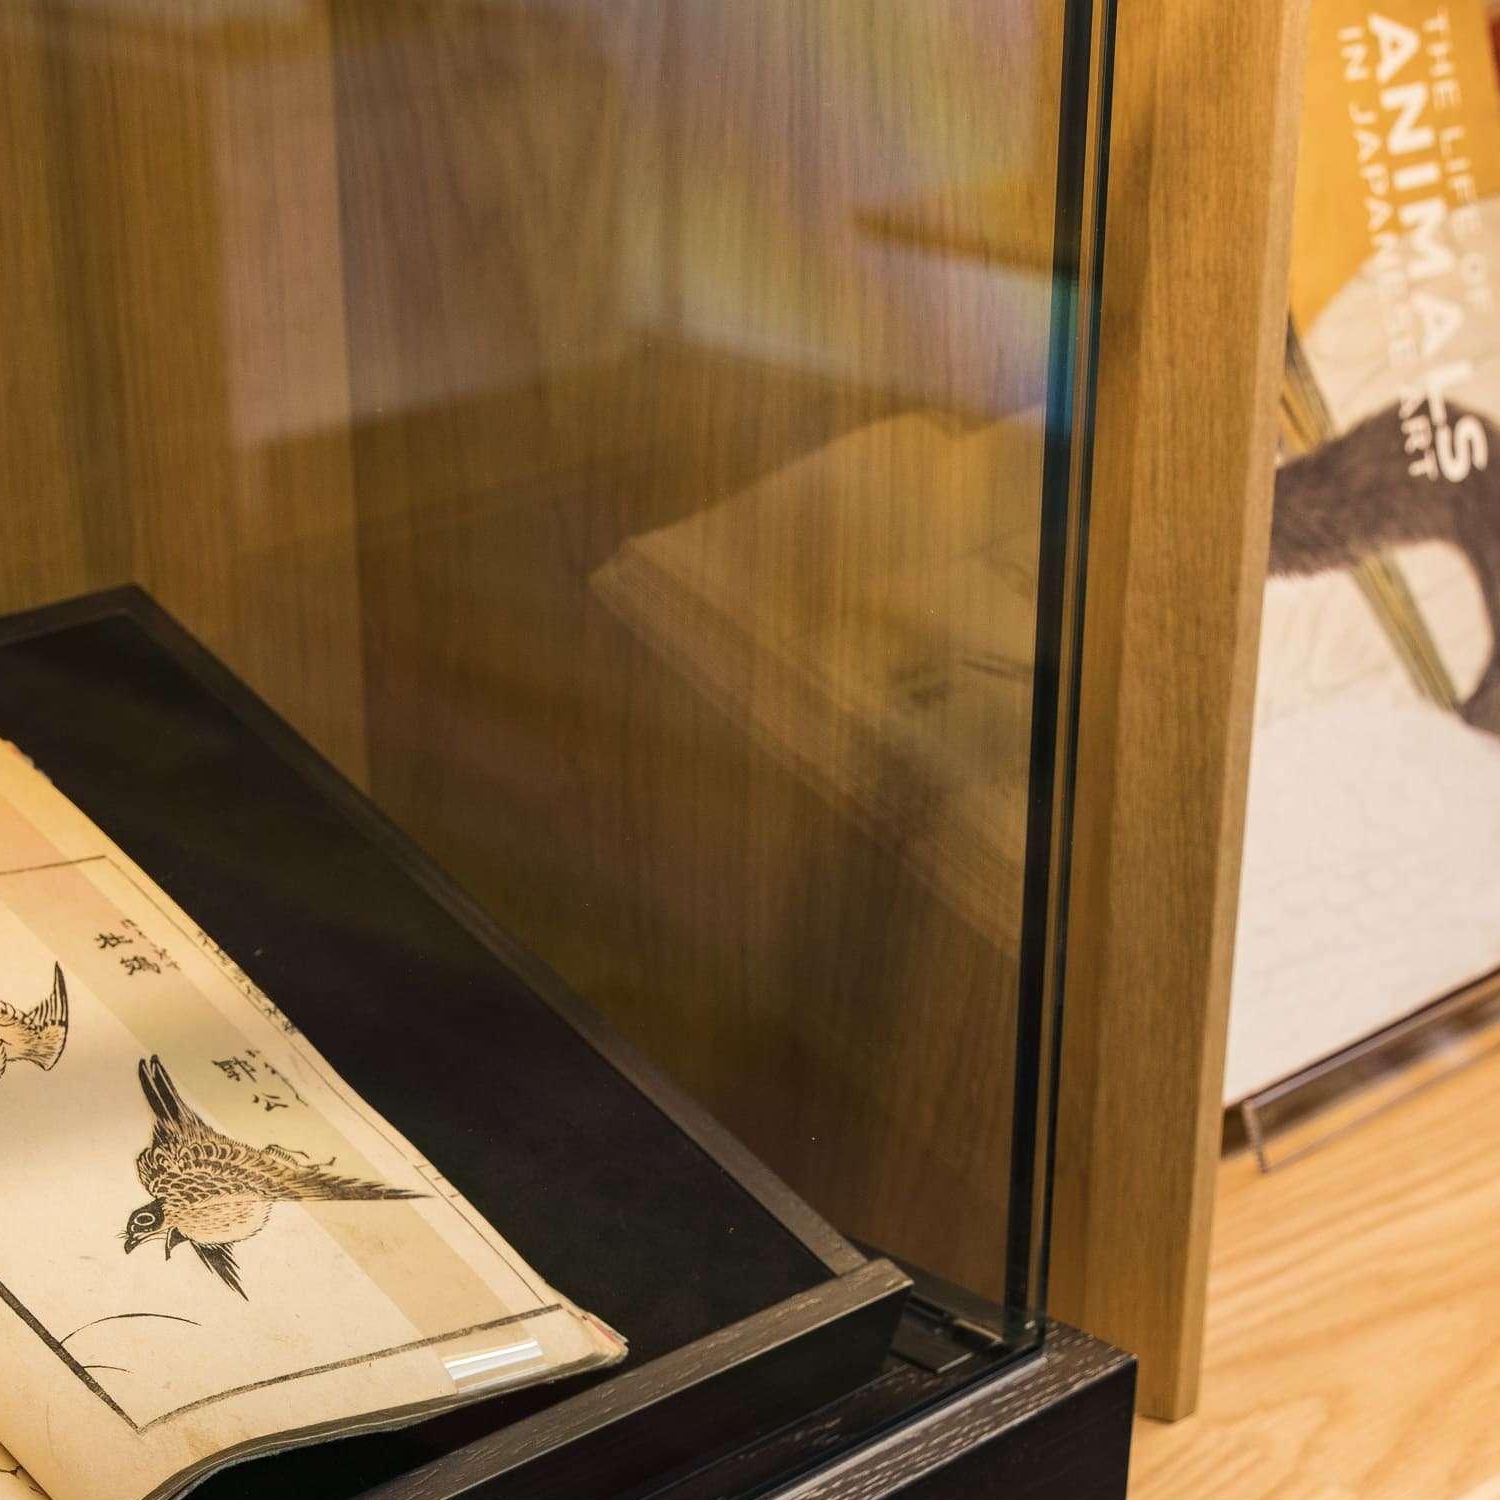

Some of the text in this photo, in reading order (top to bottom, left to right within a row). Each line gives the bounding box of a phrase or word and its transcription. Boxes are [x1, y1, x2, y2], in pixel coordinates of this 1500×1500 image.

[1338, 25, 1369, 81] IN
[1399, 383, 1439, 482] ART
[1367, 12, 1488, 483] ANIMALS
[1422, 6, 1494, 313] THE LIFE OF
